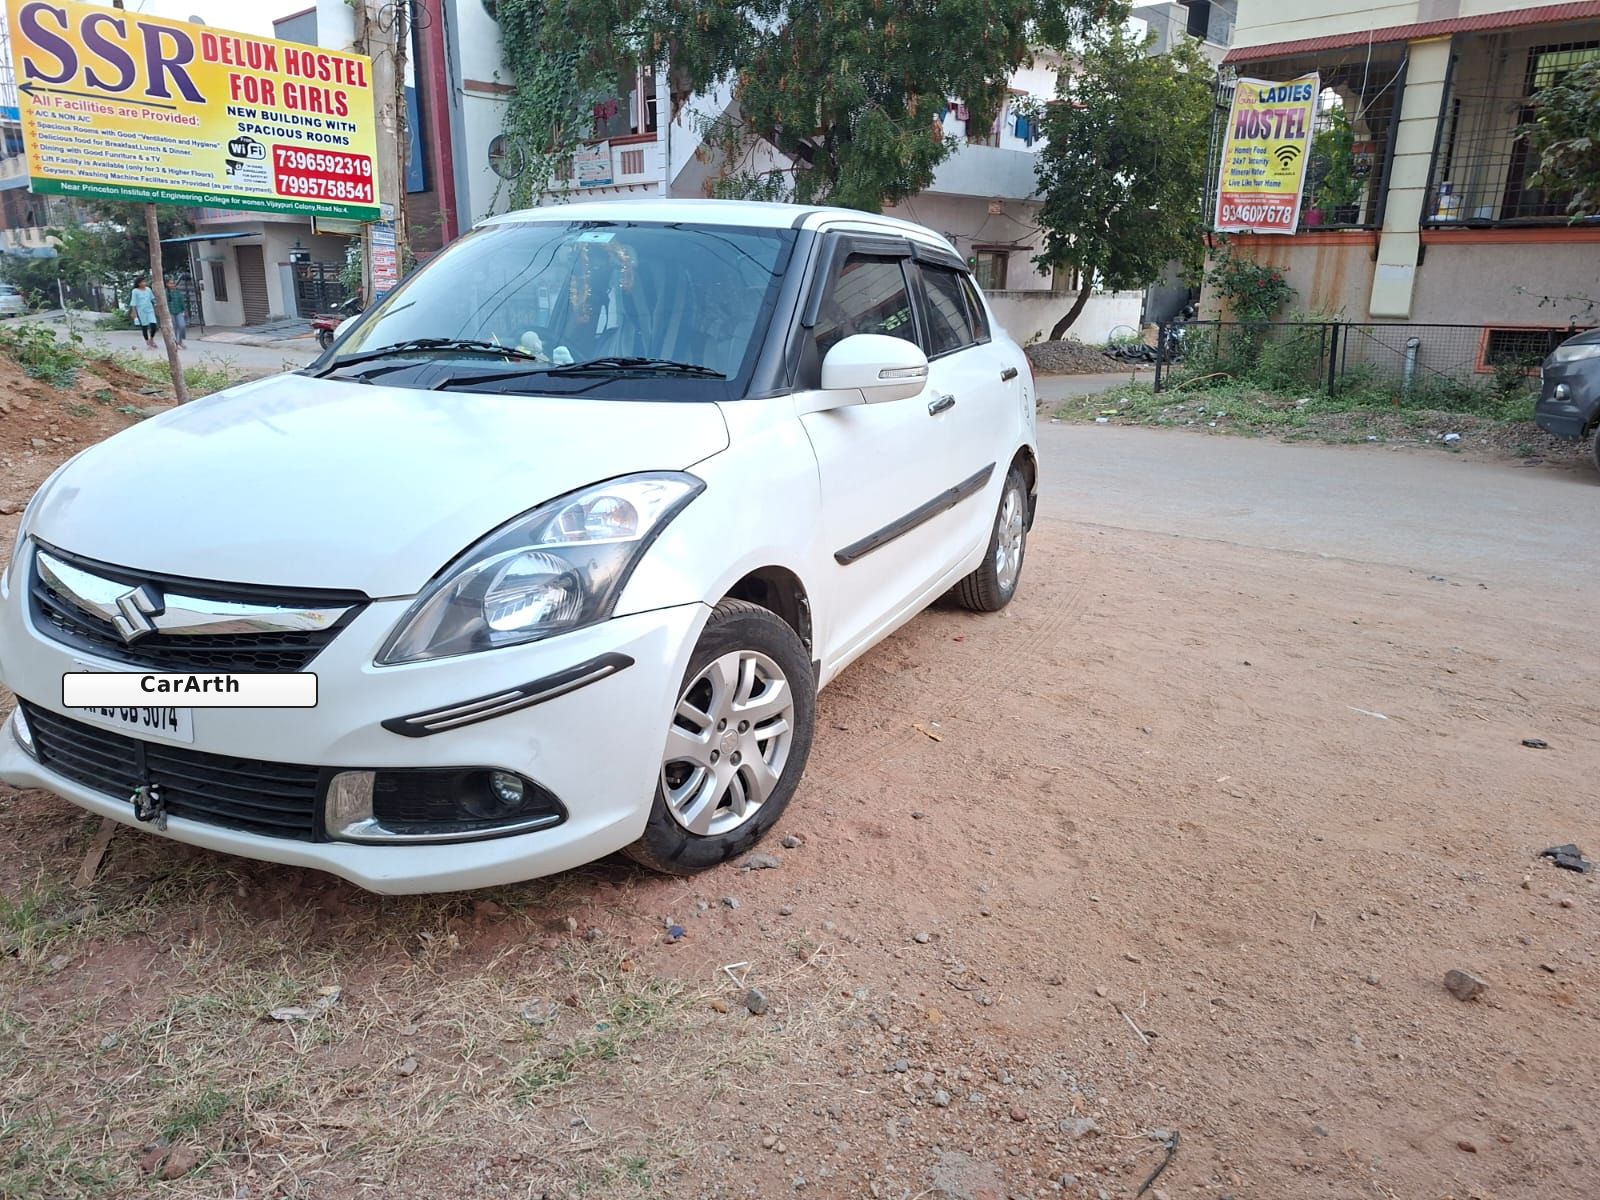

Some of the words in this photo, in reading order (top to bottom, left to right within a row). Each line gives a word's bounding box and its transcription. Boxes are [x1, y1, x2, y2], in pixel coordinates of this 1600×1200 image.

[19, 2, 206, 104] SSR
[200, 32, 279, 73] DELUX
[284, 47, 368, 88] HOSTEL
[229, 73, 276, 107] FOR
[283, 82, 349, 117] GIRLS
[1258, 84, 1312, 103] LADIES
[32, 94, 50, 107] All
[55, 97, 114, 115] Facilities
[119, 108, 138, 117] are
[142, 109, 200, 126] Provided:
[35, 110, 49, 118] A/C
[227, 106, 257, 119] NEW
[261, 109, 322, 128] BUILDING
[325, 119, 356, 133] WITH
[36, 121, 71, 131] Spacious
[73, 125, 99, 134] Rooms
[117, 131, 137, 139] Good
[237, 122, 303, 140] SPACIOUS
[306, 131, 350, 146] ROOMS
[1234, 107, 1306, 140] HOSTEL
[38, 132, 73, 143] Delicious
[74, 136, 91, 144] food
[39, 143, 64, 153] Dining
[83, 149, 103, 157] Good
[55, 156, 82, 165] Facility
[92, 160, 124, 170] Available
[168, 168, 190, 177] Higher
[78, 169, 109, 179] Washing
[110, 172, 140, 181] Machine
[276, 149, 371, 177] 7396592319
[60, 182, 80, 190] Near
[82, 184, 119, 194] Princeton
[120, 188, 150, 197] Institute
[160, 191, 203, 201] Engineering
[203, 194, 230, 205] College
[278, 174, 372, 201] 7995758541
